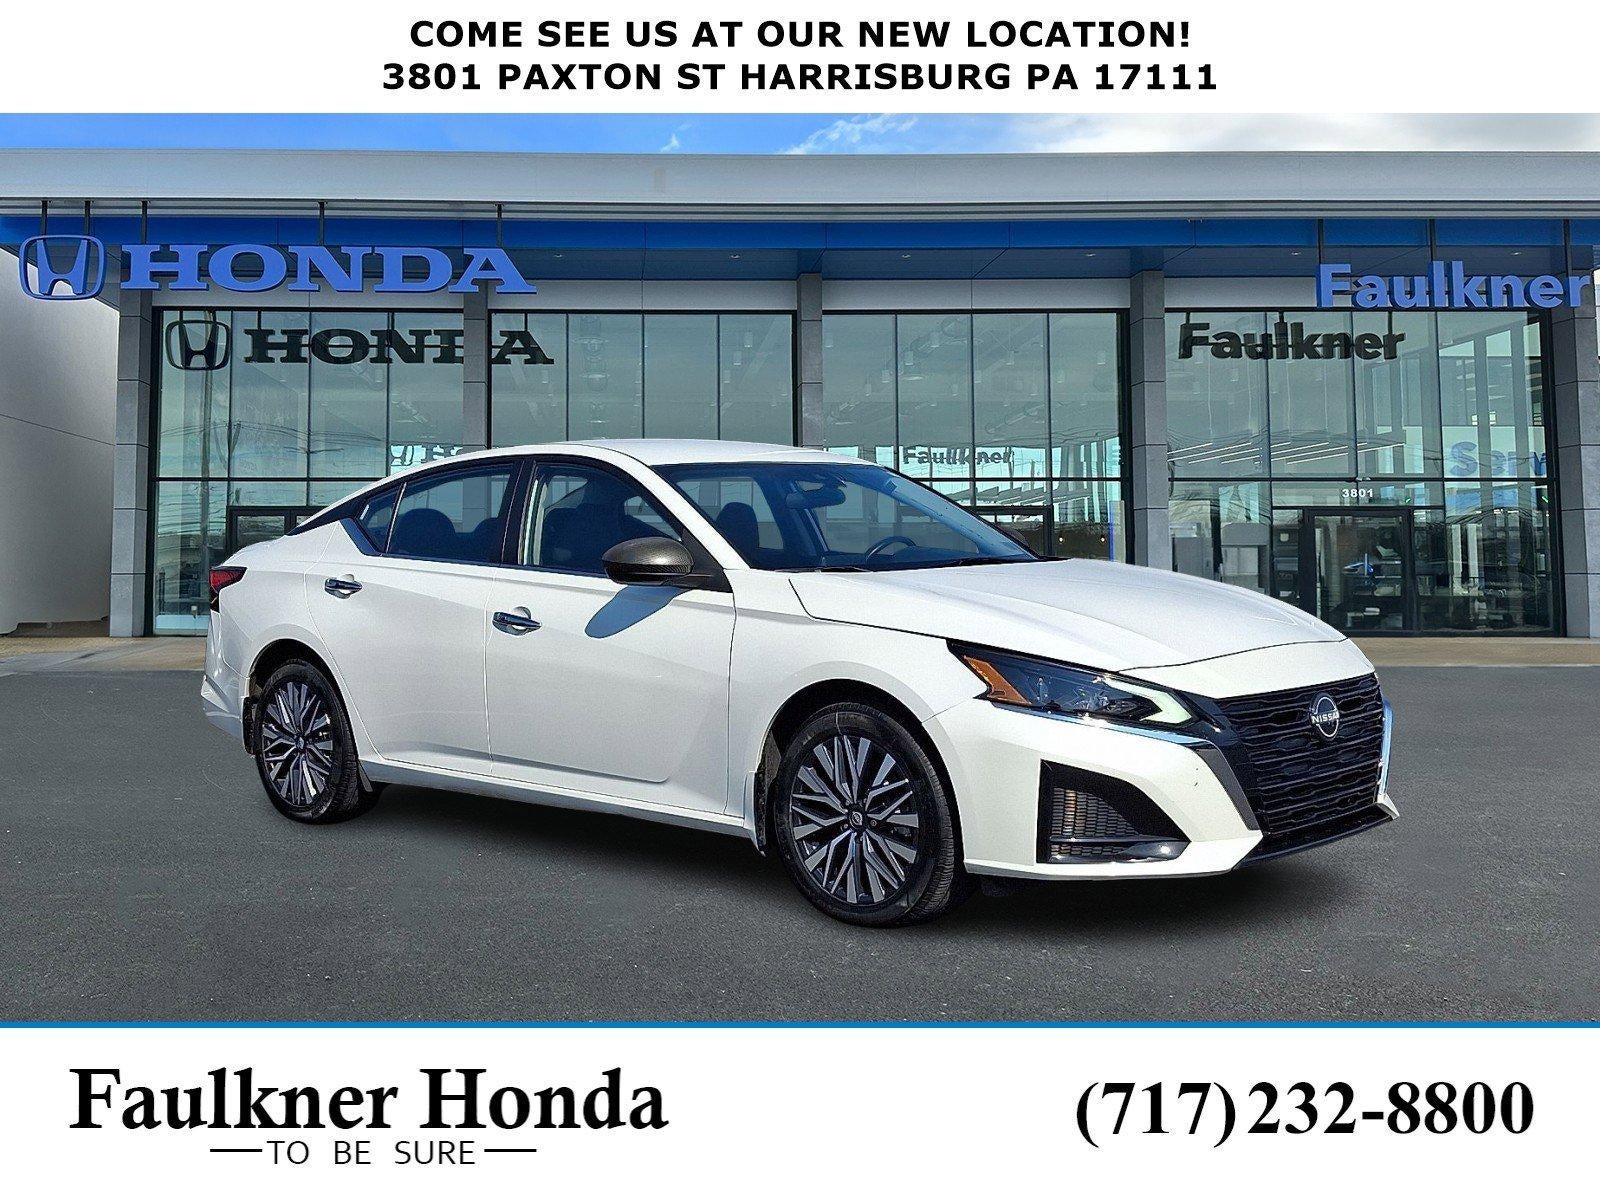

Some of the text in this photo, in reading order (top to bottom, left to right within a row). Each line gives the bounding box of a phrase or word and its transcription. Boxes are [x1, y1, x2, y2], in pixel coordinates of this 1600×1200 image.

[120, 244, 537, 295] HONDA
[1316, 261, 1591, 309] Faulkner
[1178, 322, 1406, 360] Faulkner
[1342, 488, 1373, 498] 3801
